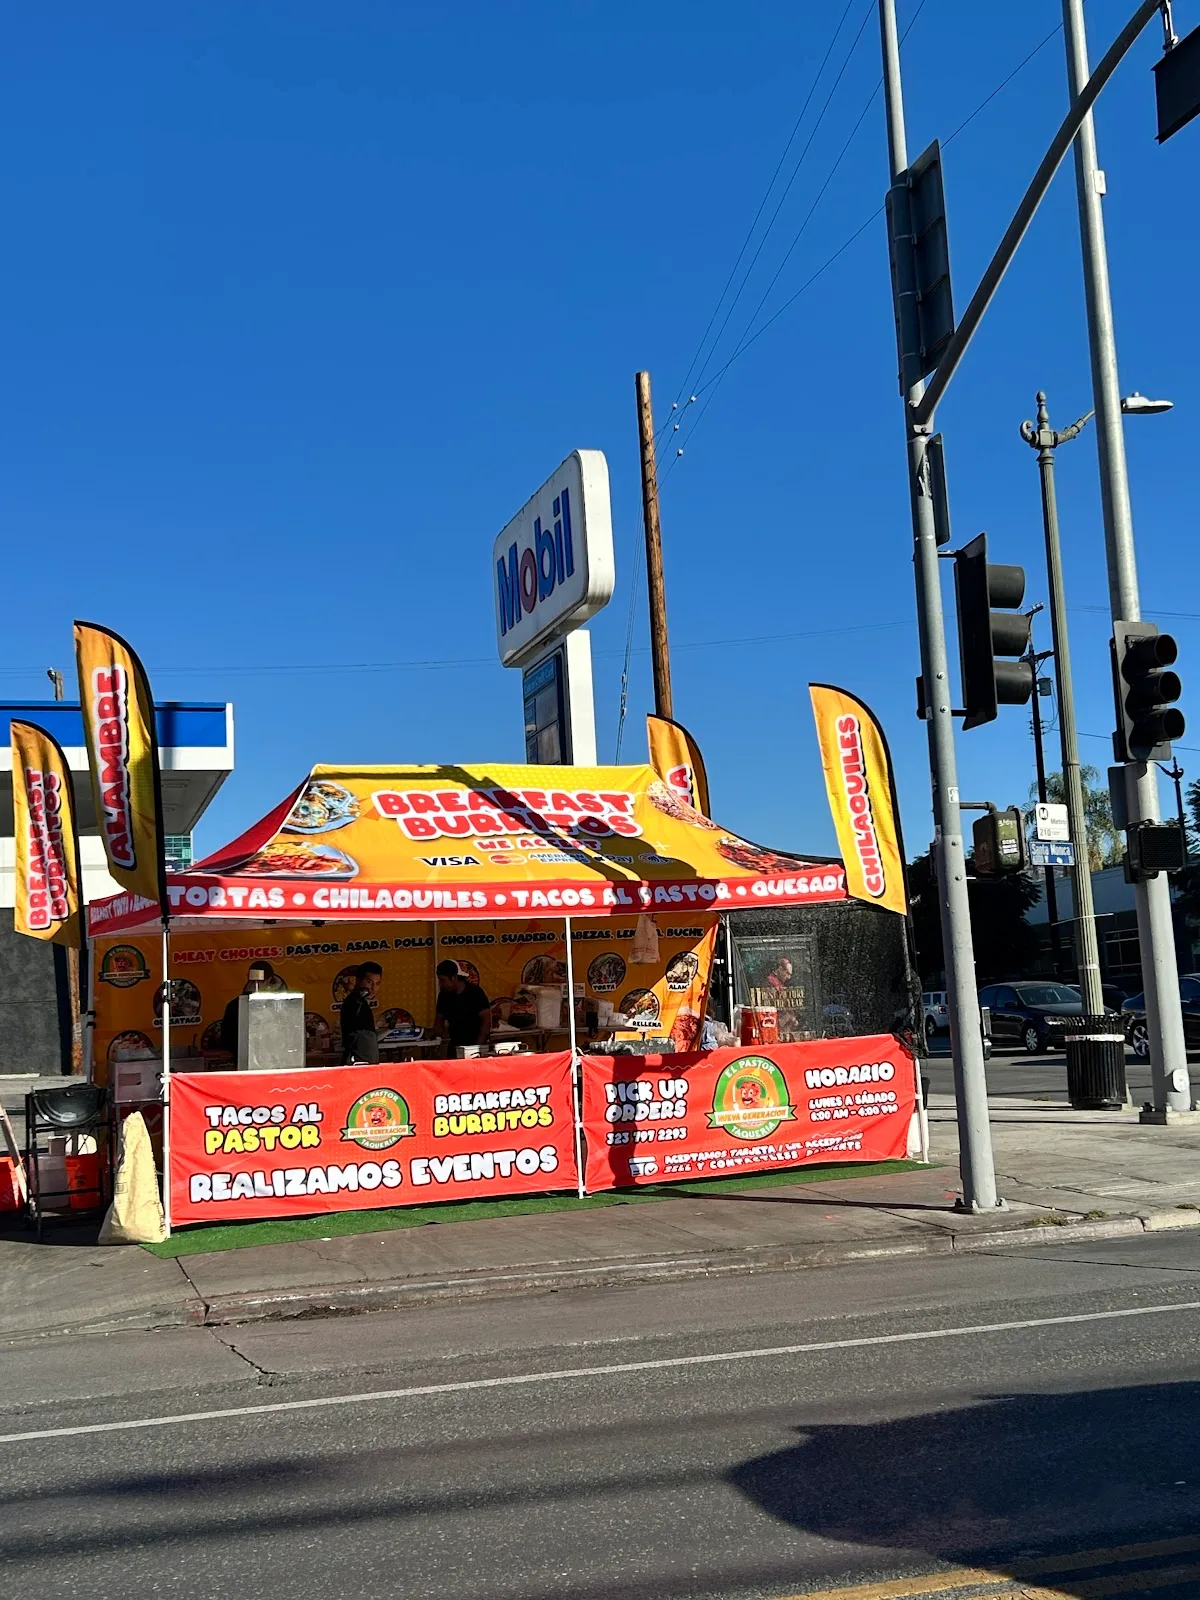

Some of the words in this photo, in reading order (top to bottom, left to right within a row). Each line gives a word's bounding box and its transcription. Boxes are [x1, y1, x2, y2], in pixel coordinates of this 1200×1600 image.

[496, 487, 575, 637] Mobil
[93, 664, 135, 869] ALAMBRE
[372, 788, 636, 818] BREAKFAST
[836, 714, 884, 896] CHILAQUILES
[397, 813, 643, 840] BURRITOS
[26, 767, 51, 928] BREAKFAST
[45, 771, 68, 919] BURRITOS
[474, 840, 512, 851] WE
[516, 837, 601, 850] ACCEPT
[417, 855, 482, 867] VISA
[528, 853, 586, 861] AMERICAN
[609, 854, 634, 864] Pay
[168, 886, 285, 908] TORTAS
[312, 888, 486, 908] CHILAQUILES
[511, 888, 595, 907] TACOS
[603, 887, 632, 906] AL
[639, 883, 731, 905] PASTOR
[173, 950, 216, 963] MEAT
[220, 946, 283, 961] CHOICES:
[394, 936, 434, 949] POLLO
[666, 928, 704, 938] BUCHE
[153, 1016, 202, 1026] QUSATACO
[724, 1067, 737, 1078] EL
[738, 1059, 775, 1075] PASTOR
[804, 1061, 895, 1089] HORARIO
[370, 1091, 399, 1102] PASTOR
[434, 1085, 552, 1115] BREAKFAST
[604, 1080, 654, 1103] PICK
[658, 1077, 689, 1100] UP
[808, 1095, 843, 1109] LUNES
[844, 1094, 853, 1106] A
[205, 1105, 286, 1126] TACOS
[292, 1102, 323, 1123] AL
[433, 1106, 554, 1137] BURRITOS
[605, 1100, 687, 1123] ORDERS
[718, 1113, 740, 1121] NUEVA
[832, 1108, 849, 1120] AM
[880, 1103, 899, 1114] PM
[204, 1124, 322, 1155] PASTOR
[606, 1131, 630, 1145] 323
[633, 1129, 656, 1143] 797
[731, 1121, 775, 1138] TAQUERIA
[361, 1136, 398, 1149] TAQUERIA
[664, 1150, 727, 1165] ACEPTAMOS
[729, 1145, 776, 1158] TARJETA
[805, 1136, 843, 1148] ACCEPT
[189, 1159, 402, 1203] REALIZAMOS
[410, 1145, 558, 1186] EVENTOS
[696, 1161, 705, 1171] Y
